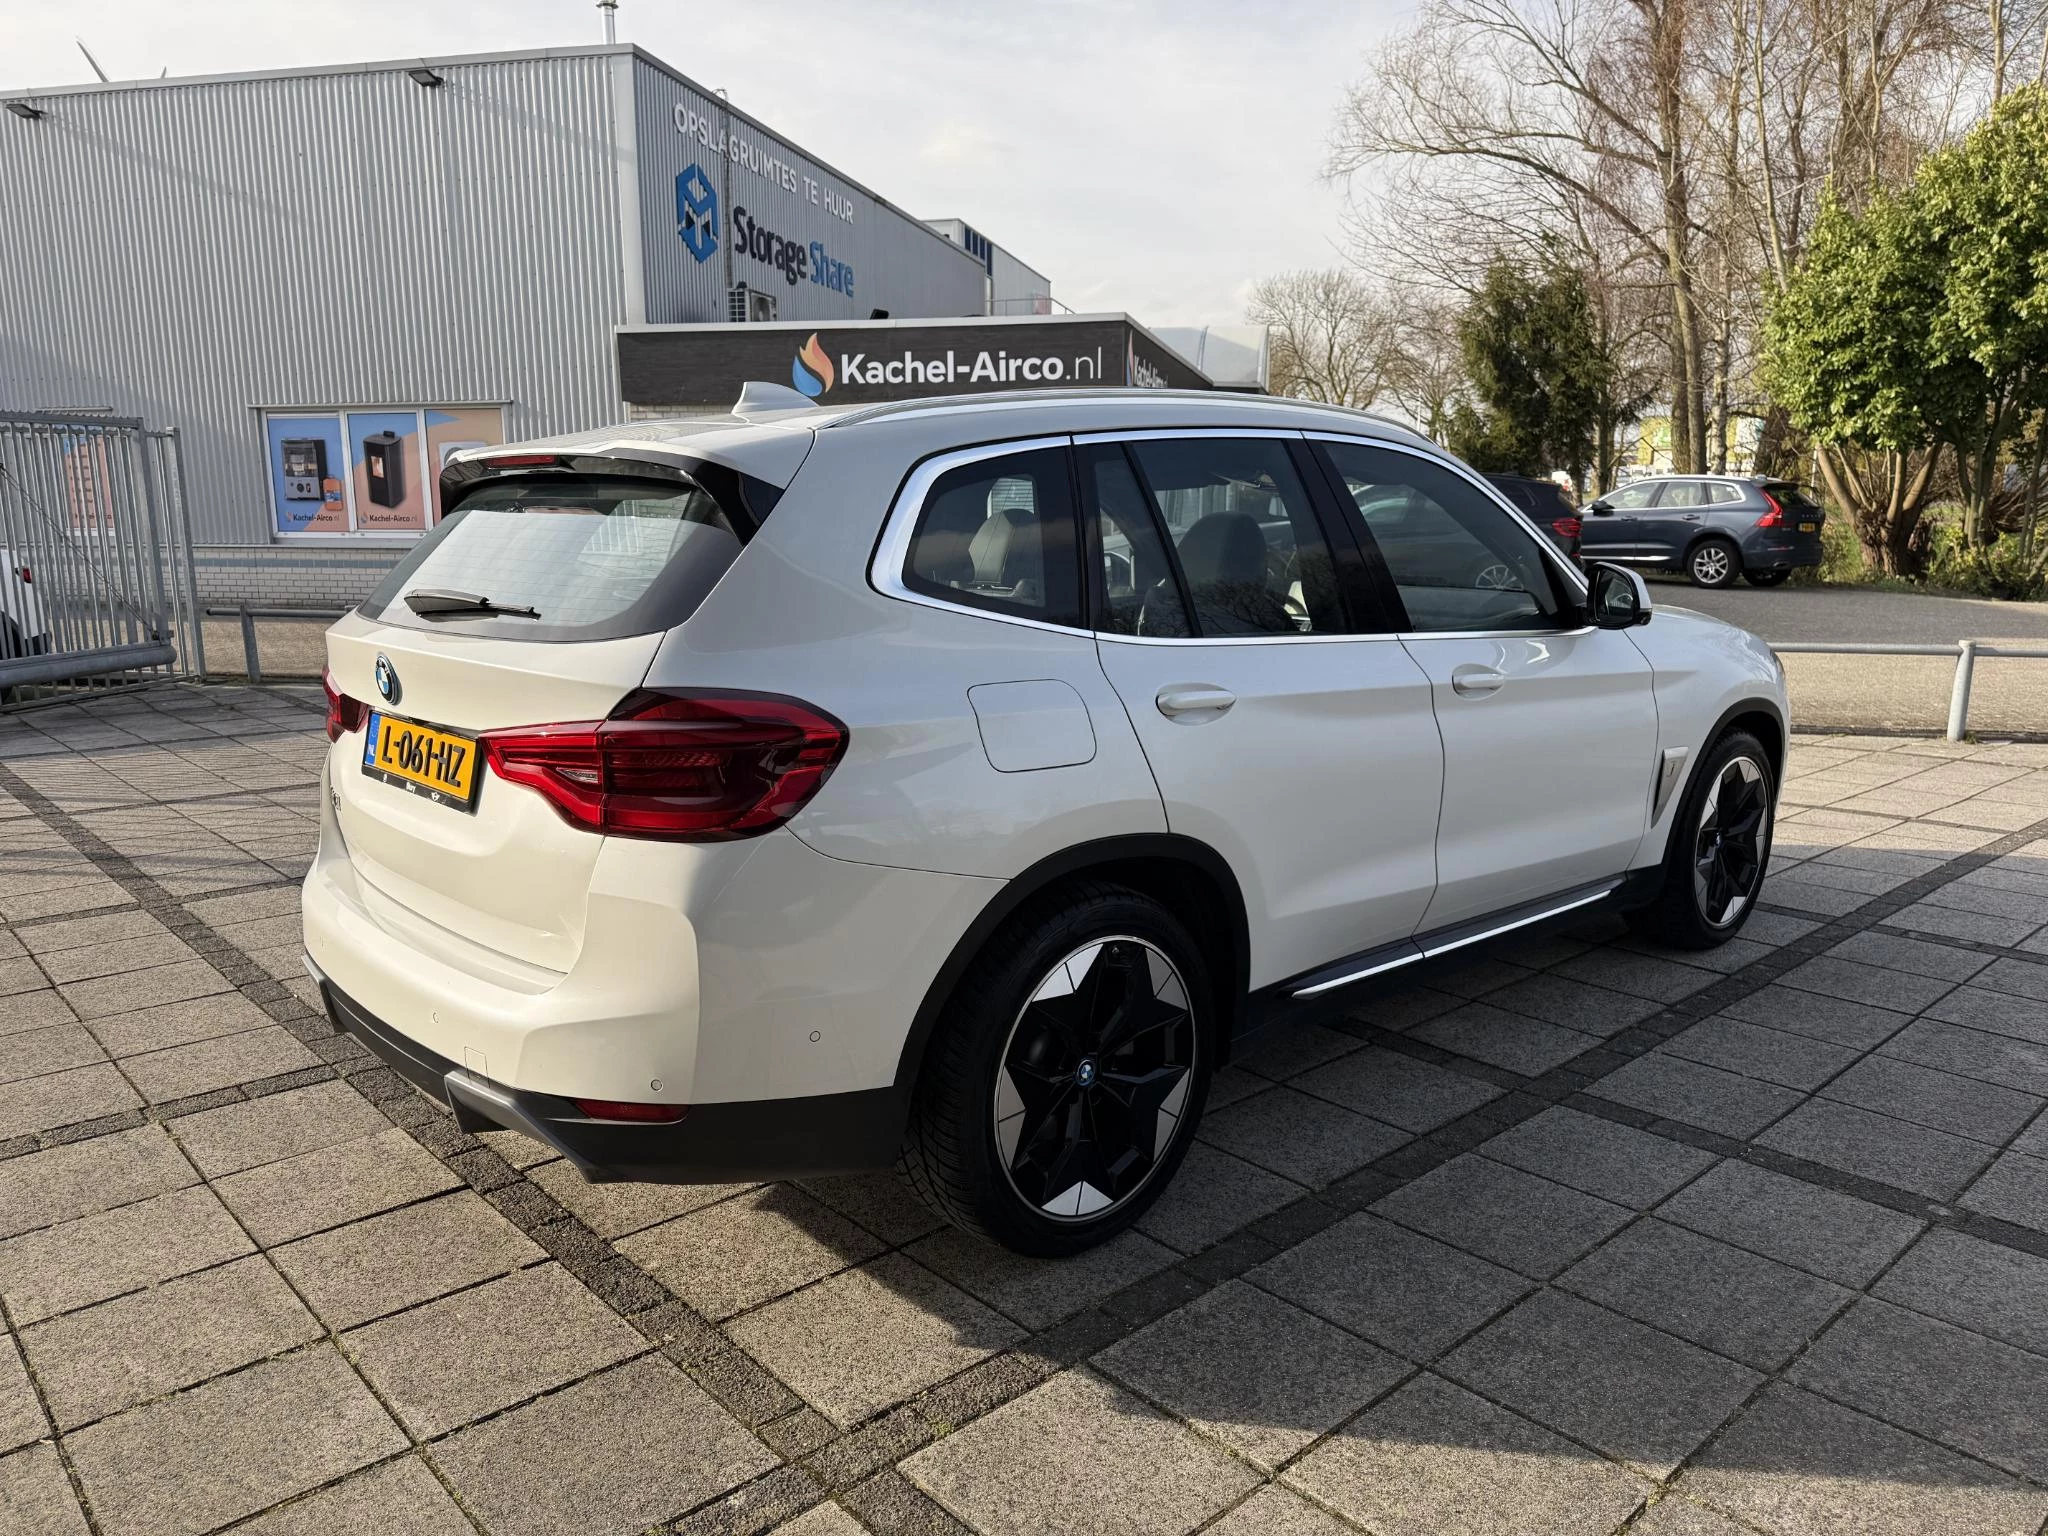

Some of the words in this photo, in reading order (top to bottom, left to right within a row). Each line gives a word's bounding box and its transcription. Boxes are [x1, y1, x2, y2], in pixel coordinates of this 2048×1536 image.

[674, 103, 797, 193] OPSLAGRUIMTES
[803, 176, 818, 205] TE
[824, 188, 853, 224] HUUR
[733, 206, 807, 286] Storage
[810, 241, 854, 298] Share
[841, 346, 1101, 384] Kachel-Airco.nl
[381, 725, 466, 788] L-061-HZ
